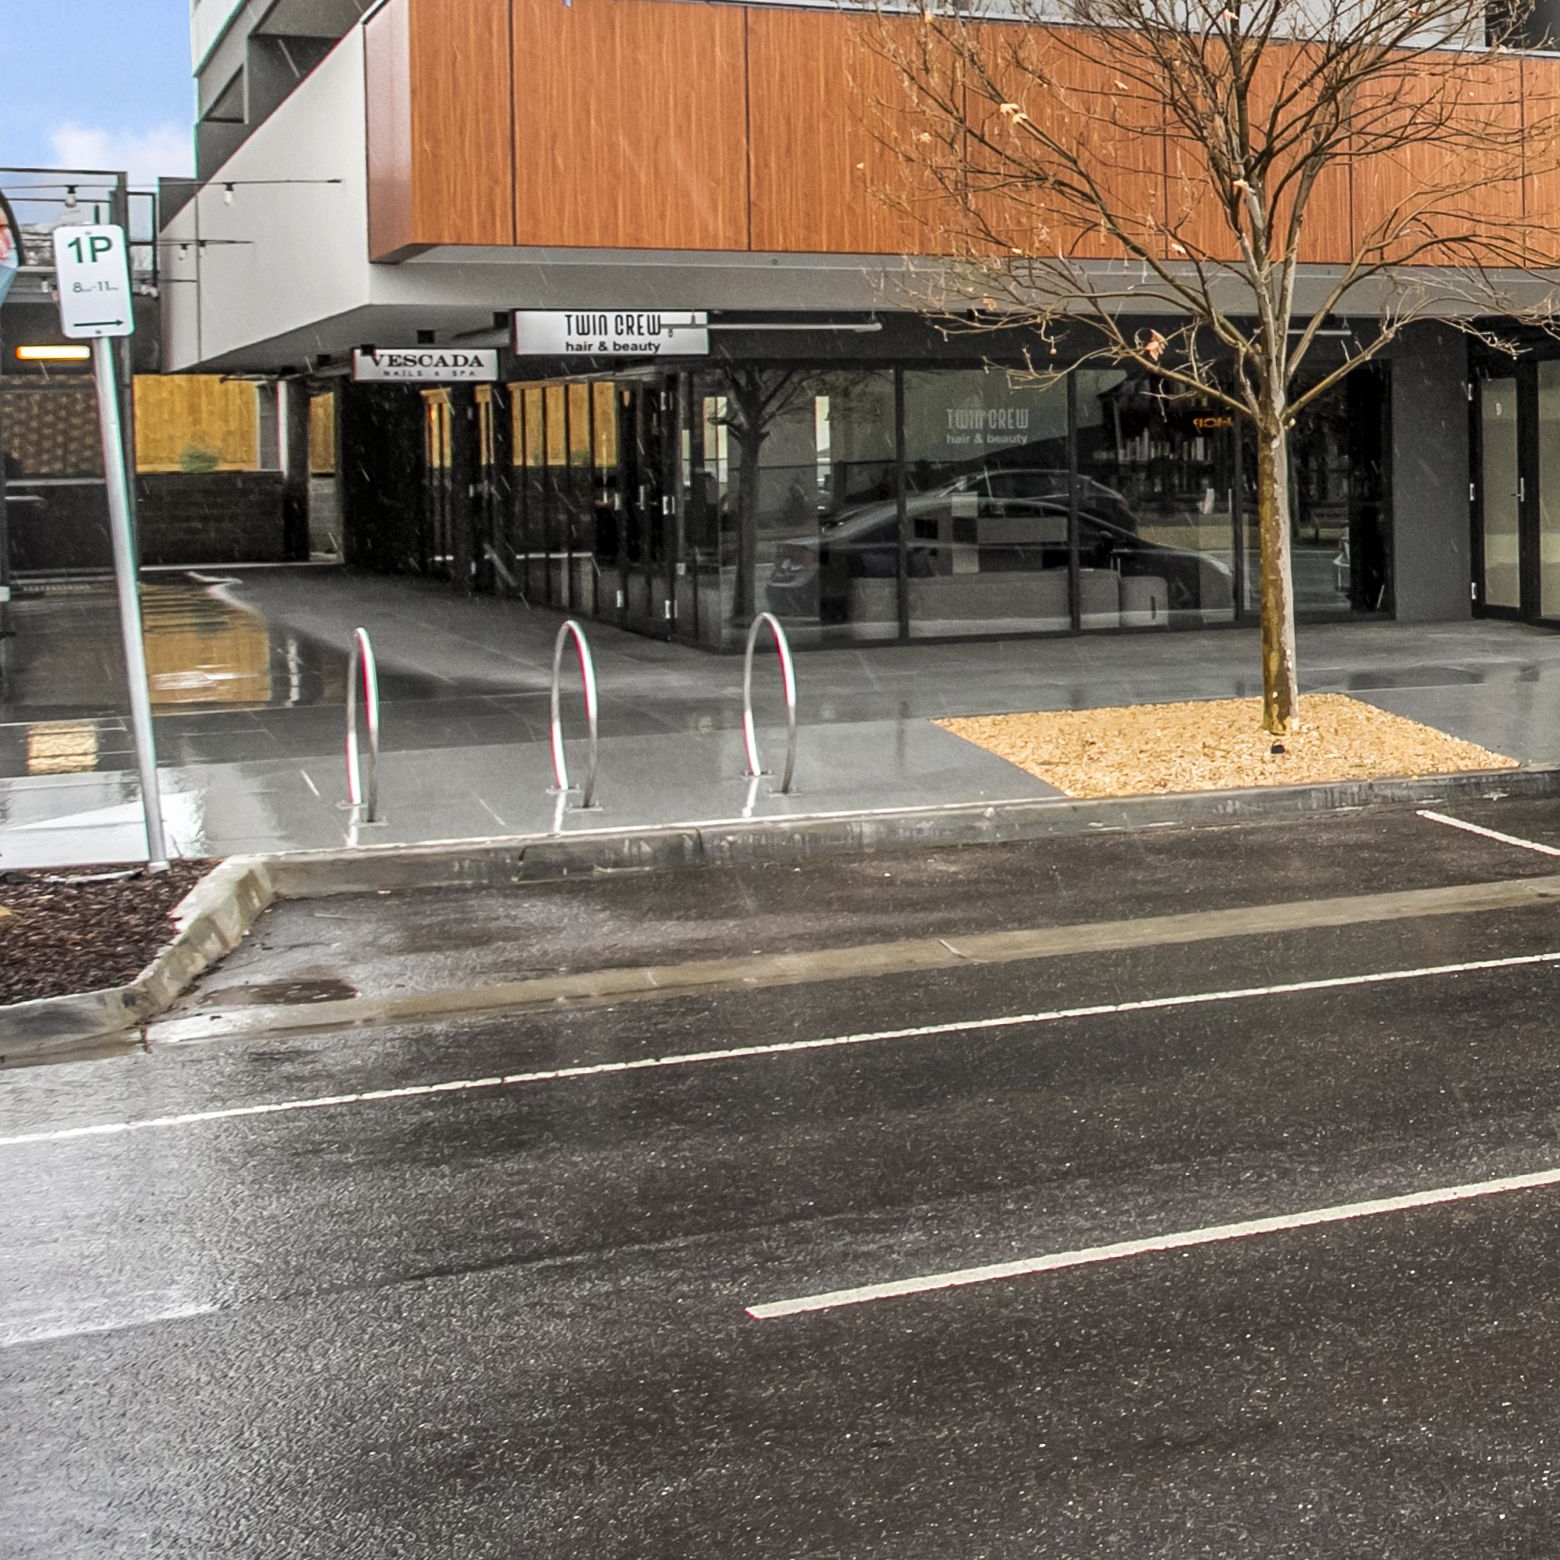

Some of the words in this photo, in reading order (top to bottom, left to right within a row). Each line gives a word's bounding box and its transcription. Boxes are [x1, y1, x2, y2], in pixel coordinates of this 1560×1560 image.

[68, 236, 113, 263] 1P
[565, 314, 608, 336] TWIN
[615, 314, 661, 336] CREW
[566, 341, 593, 352] hair
[598, 342, 608, 351] &
[613, 341, 661, 353] beauty
[370, 354, 484, 367] VESCADA
[946, 408, 986, 429] TWIN
[989, 408, 1029, 429] CREW
[946, 434, 970, 444] hair
[987, 434, 1028, 445] beauty
